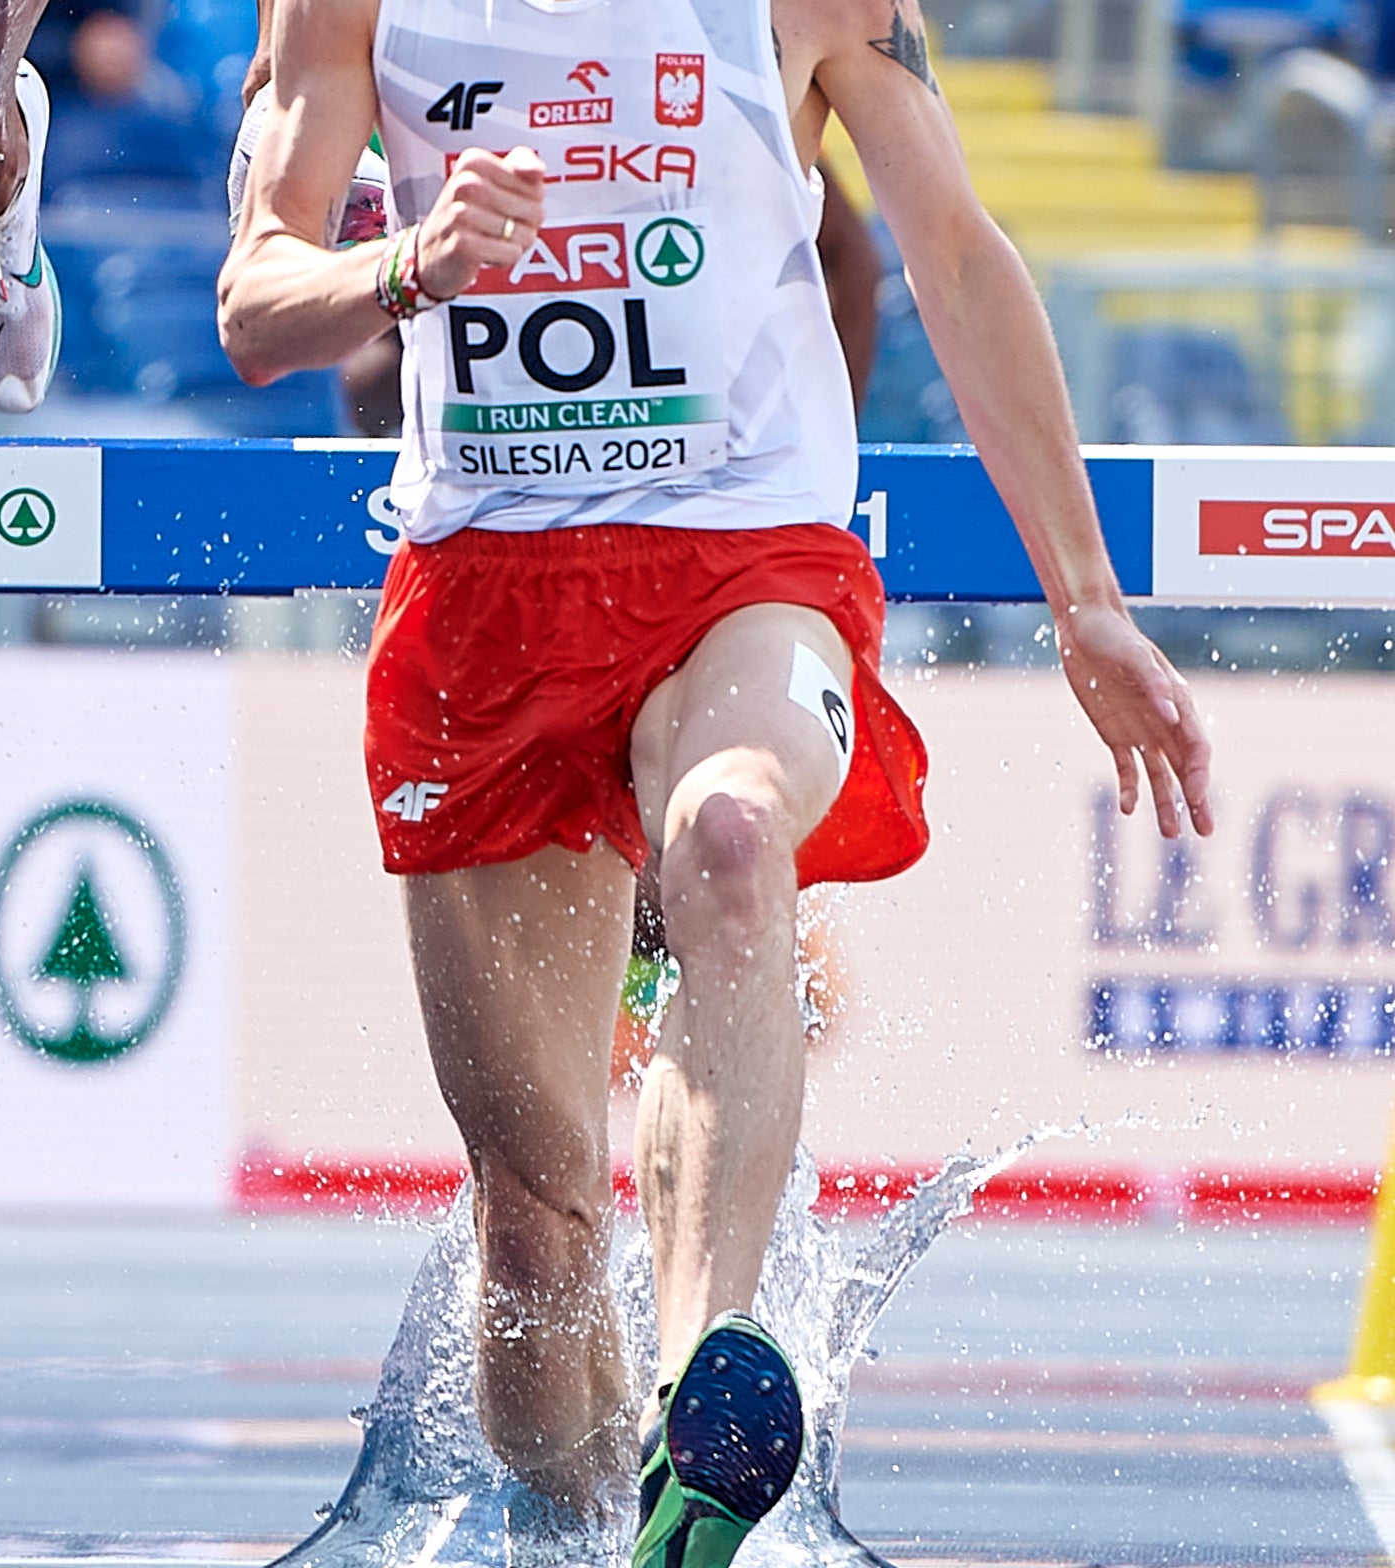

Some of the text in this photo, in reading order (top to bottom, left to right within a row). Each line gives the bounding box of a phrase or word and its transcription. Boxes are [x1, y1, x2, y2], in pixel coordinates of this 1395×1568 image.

[426, 82, 504, 130] 4F
[533, 101, 609, 125] ORLEN
[447, 297, 688, 396] POL
[491, 406, 553, 430] RUN
[460, 437, 688, 476] SILESIA 2021
[382, 780, 450, 824] 4F
